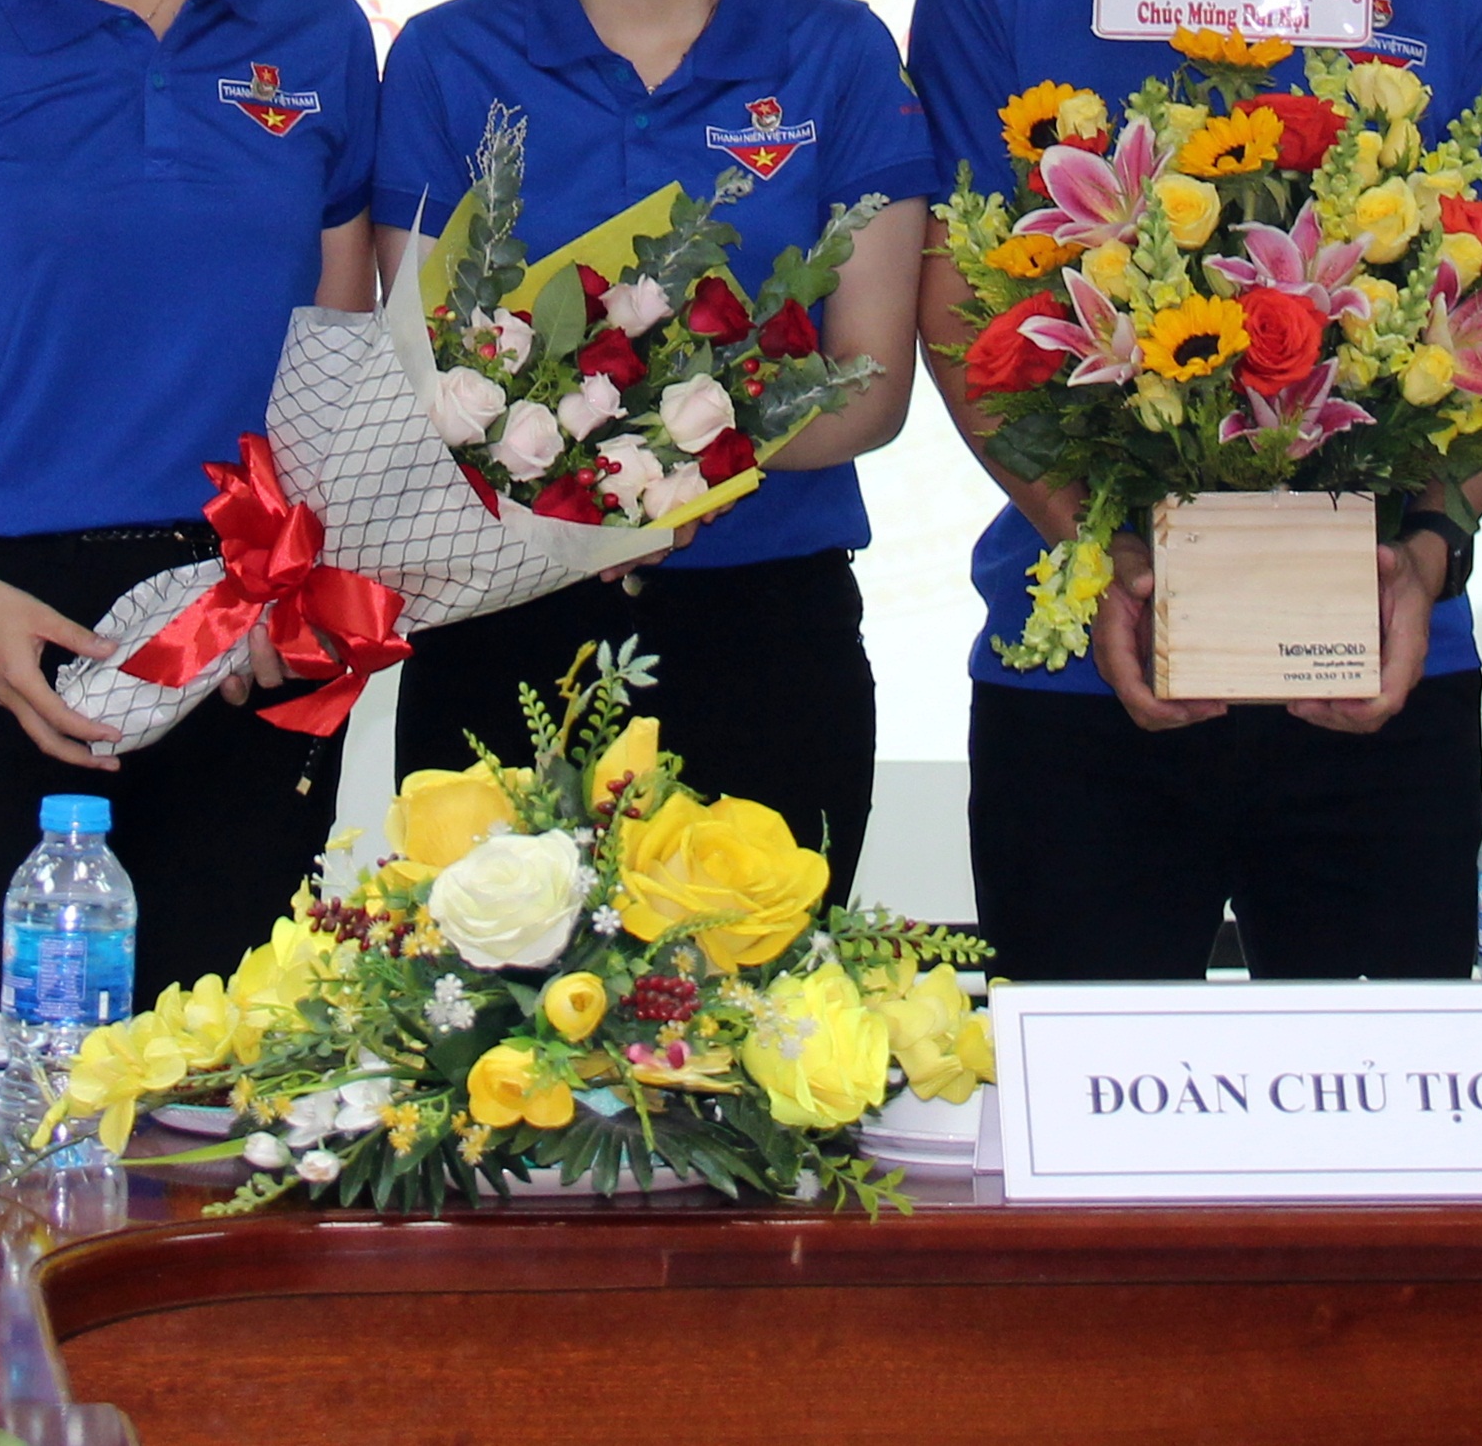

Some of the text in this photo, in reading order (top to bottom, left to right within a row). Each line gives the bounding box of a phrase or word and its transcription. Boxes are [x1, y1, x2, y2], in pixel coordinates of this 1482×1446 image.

[1137, 0, 1183, 25] Chúc
[1188, 1, 1237, 32] Mừng
[222, 85, 253, 98] THAN
[711, 132, 742, 143] THANH
[788, 127, 811, 139] NAM
[1085, 1061, 1250, 1115] ĐOÀN
[1268, 1059, 1390, 1114] CHỦ
